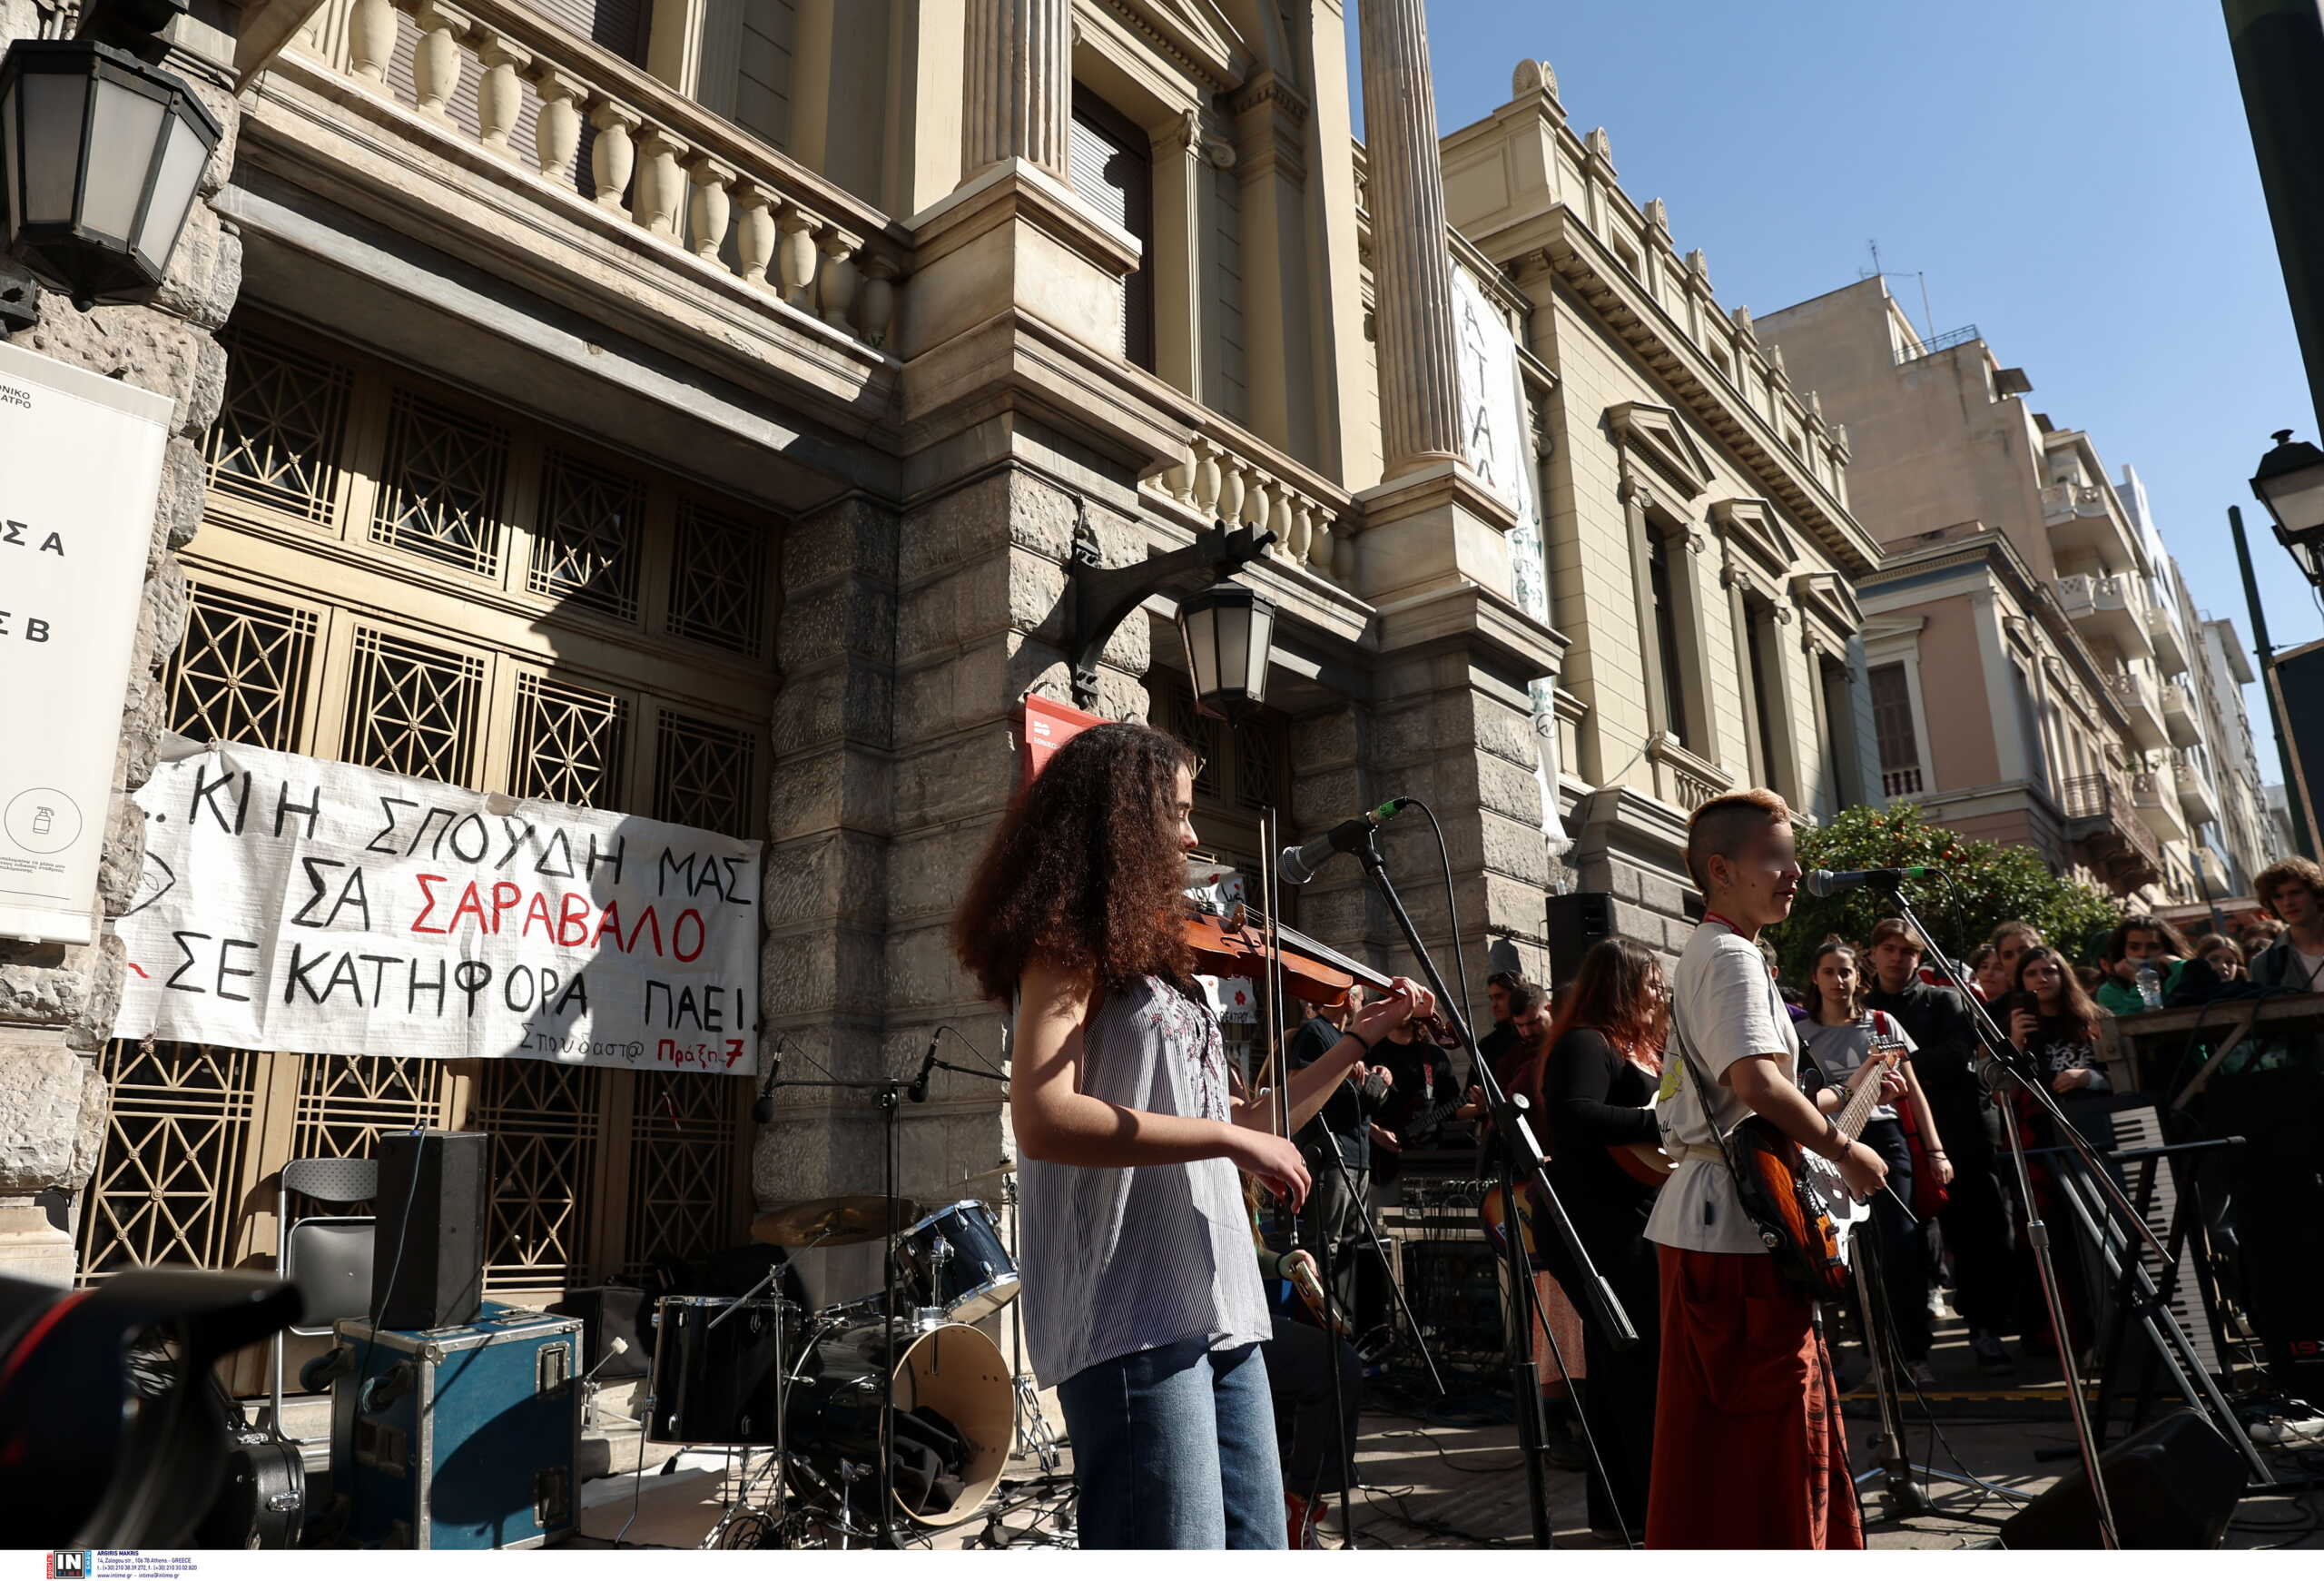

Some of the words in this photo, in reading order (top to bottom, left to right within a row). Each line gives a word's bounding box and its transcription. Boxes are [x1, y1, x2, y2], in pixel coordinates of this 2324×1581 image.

[0, 385, 30, 400] ΝΙΚΟ
[0, 519, 28, 547] Σ
[39, 531, 64, 557] Α
[25, 617, 49, 643] Β
[274, 780, 320, 840] Η
[365, 796, 625, 884] ΣΠΟΥΔΗ
[658, 846, 752, 904] ΜΑΣ
[290, 856, 370, 932] ΣΑ
[410, 874, 705, 963] ΣΑΡΑΒΑΛΟ
[165, 931, 260, 1002] ΣΕ
[284, 943, 588, 1018] ΚΑΤΗΦΟΡΑ
